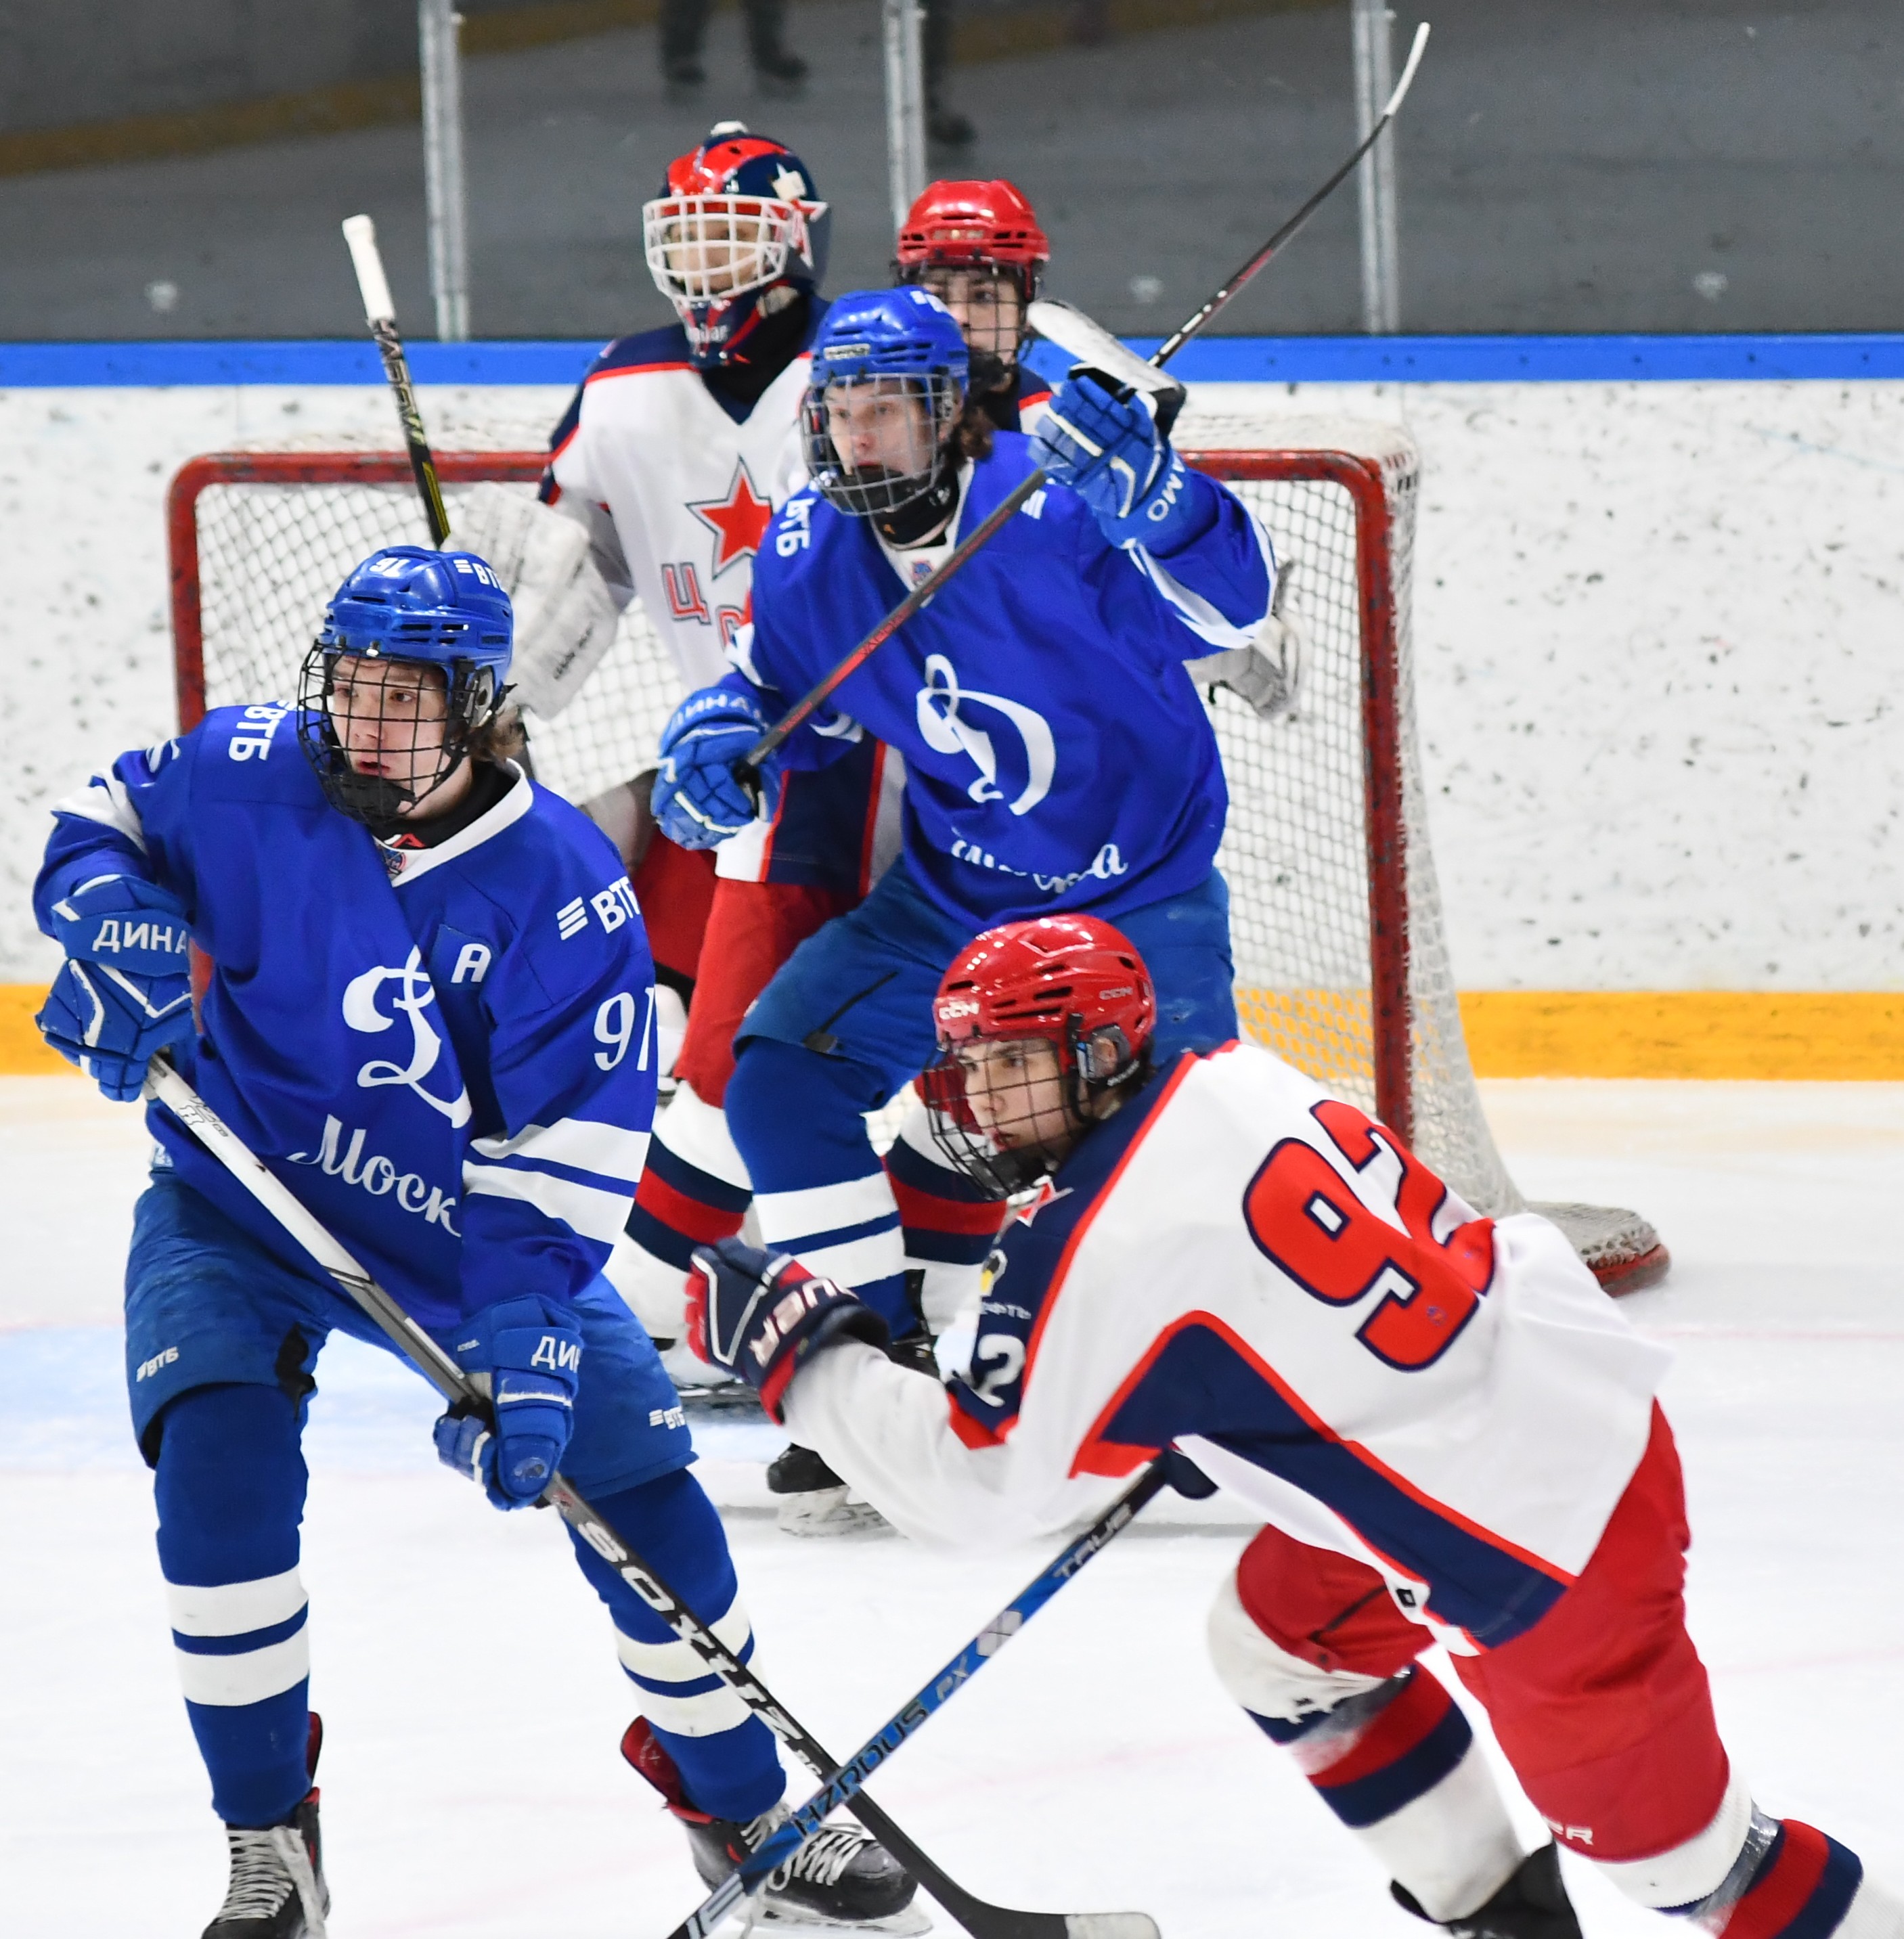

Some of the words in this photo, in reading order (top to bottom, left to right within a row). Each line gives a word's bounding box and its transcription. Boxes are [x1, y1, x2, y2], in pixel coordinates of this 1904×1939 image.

[369, 558, 411, 577] 91
[228, 706, 288, 762] ВТБ
[593, 986, 657, 1072] 91
[1242, 1099, 1497, 1375] 92
[146, 1345, 179, 1378] ВТБ
